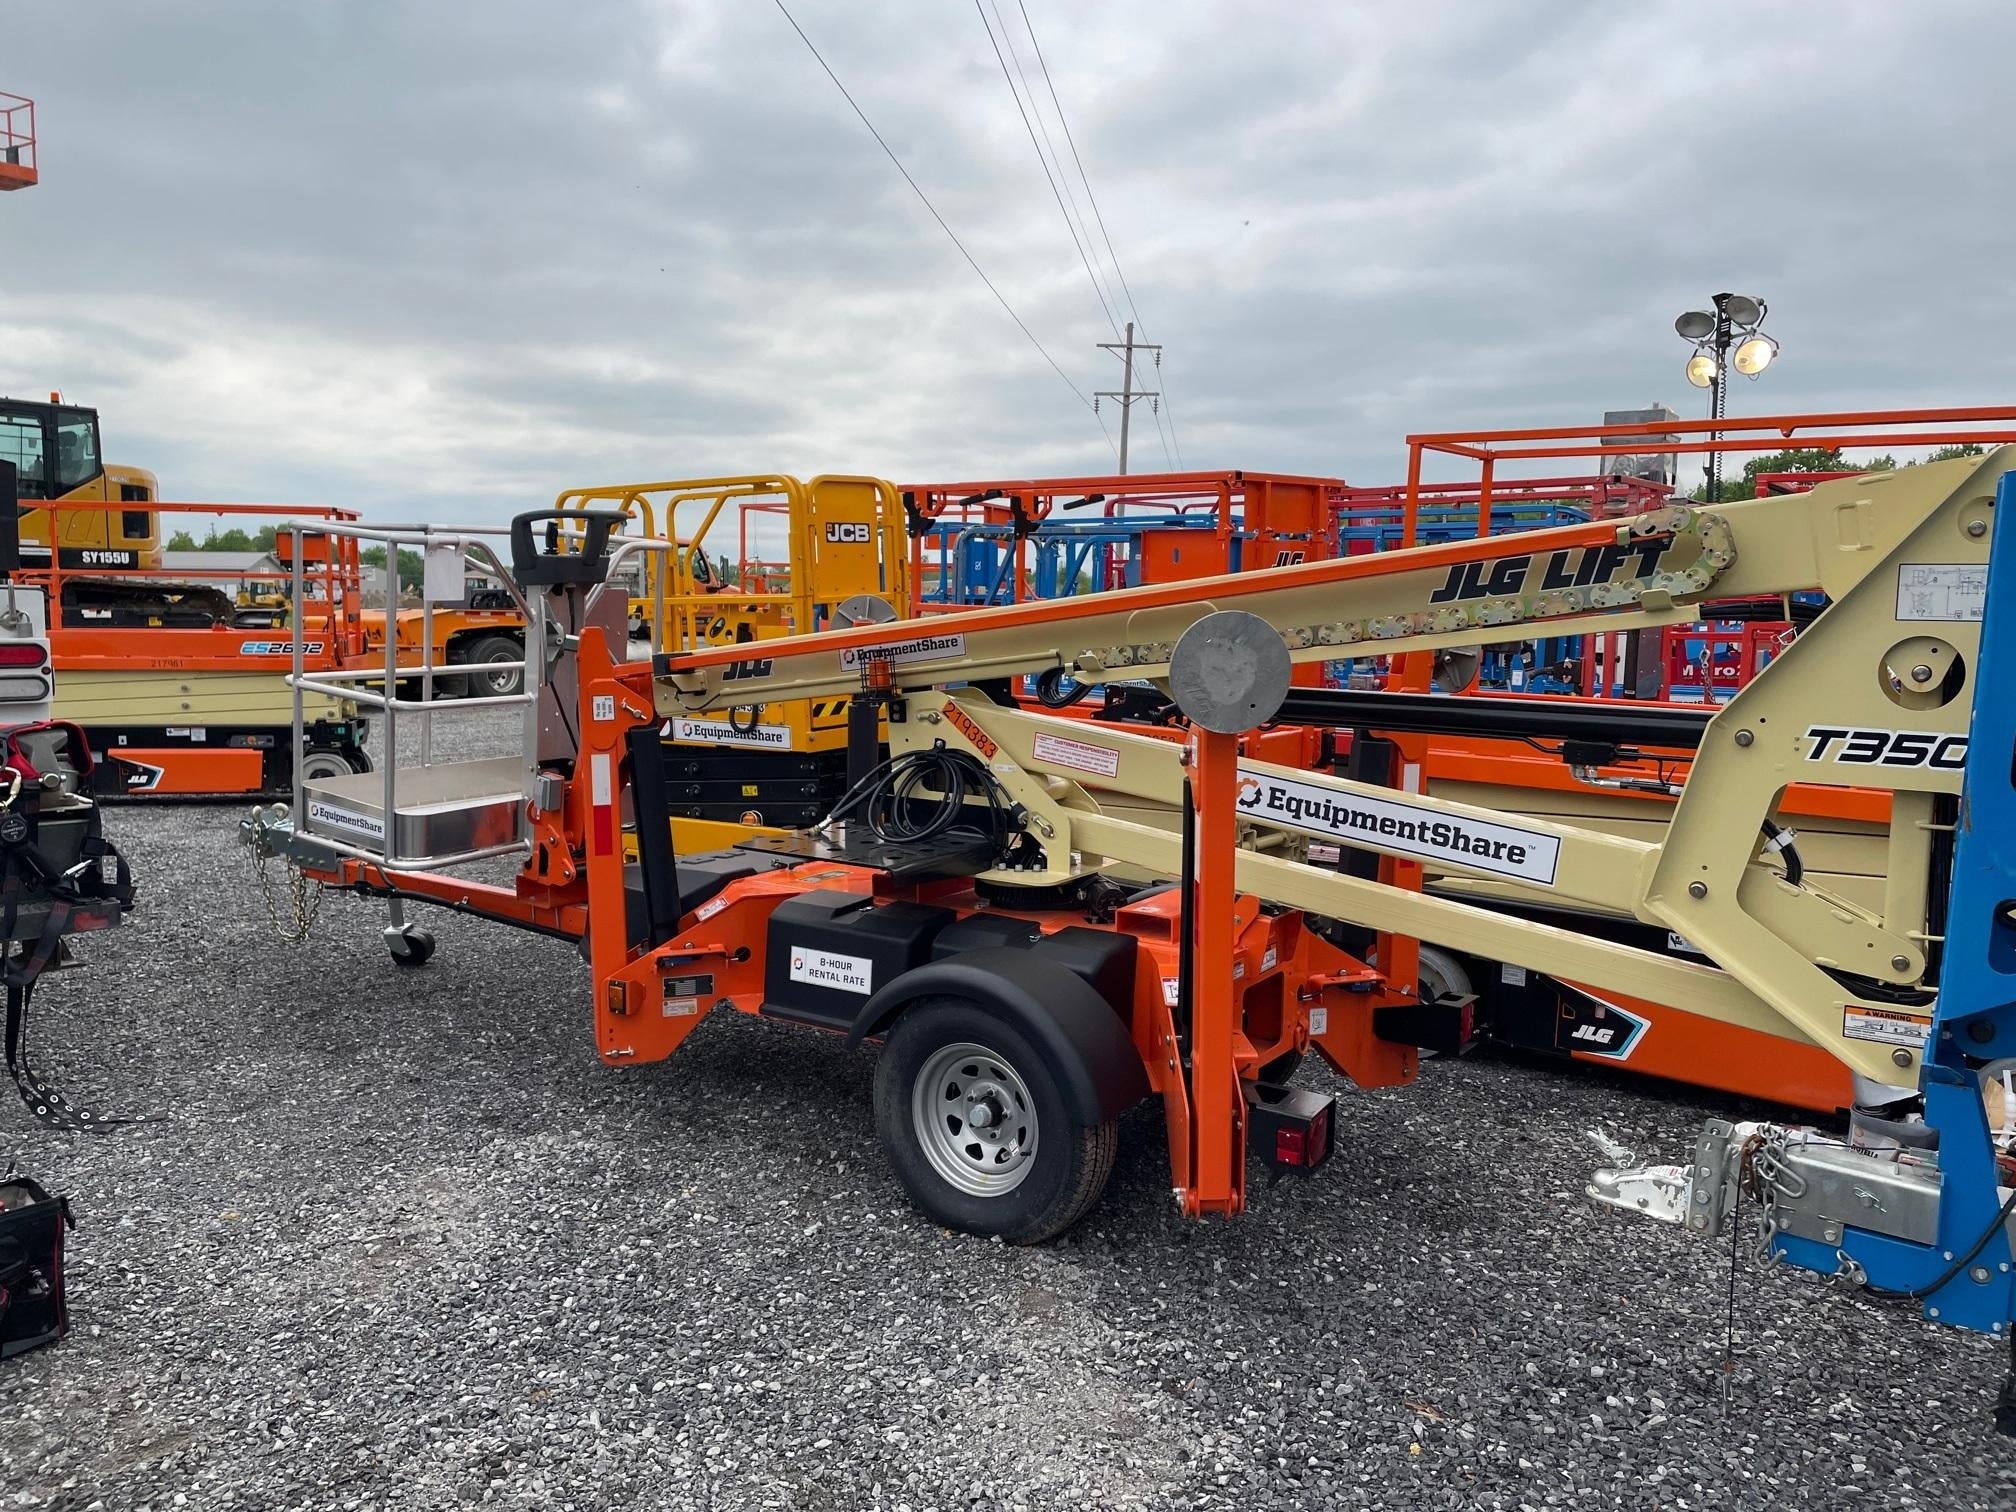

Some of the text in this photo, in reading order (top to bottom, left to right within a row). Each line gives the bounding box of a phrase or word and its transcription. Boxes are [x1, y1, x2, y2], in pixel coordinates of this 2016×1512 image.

[827, 524, 869, 541] JCB
[82, 551, 129, 564] SY155U
[1430, 536, 1675, 604] JLG LIFT
[856, 637, 958, 661] EquipmentShare
[723, 659, 773, 680] JLG
[694, 725, 782, 742] EquipmentShare
[942, 702, 997, 759] 219383
[1054, 739, 1118, 758] CUSTOMER RESPONSIBILITY
[1807, 729, 1969, 769] T350
[128, 775, 148, 783] JLG
[319, 807, 383, 833] EquipmentShare
[1266, 787, 1527, 865] EquipmentShare
[819, 957, 853, 972] 8-HOUR
[809, 969, 865, 987] RENTAL RATE
[1871, 1010, 1912, 1022] WARNING
[1571, 1024, 1615, 1044] JLG
